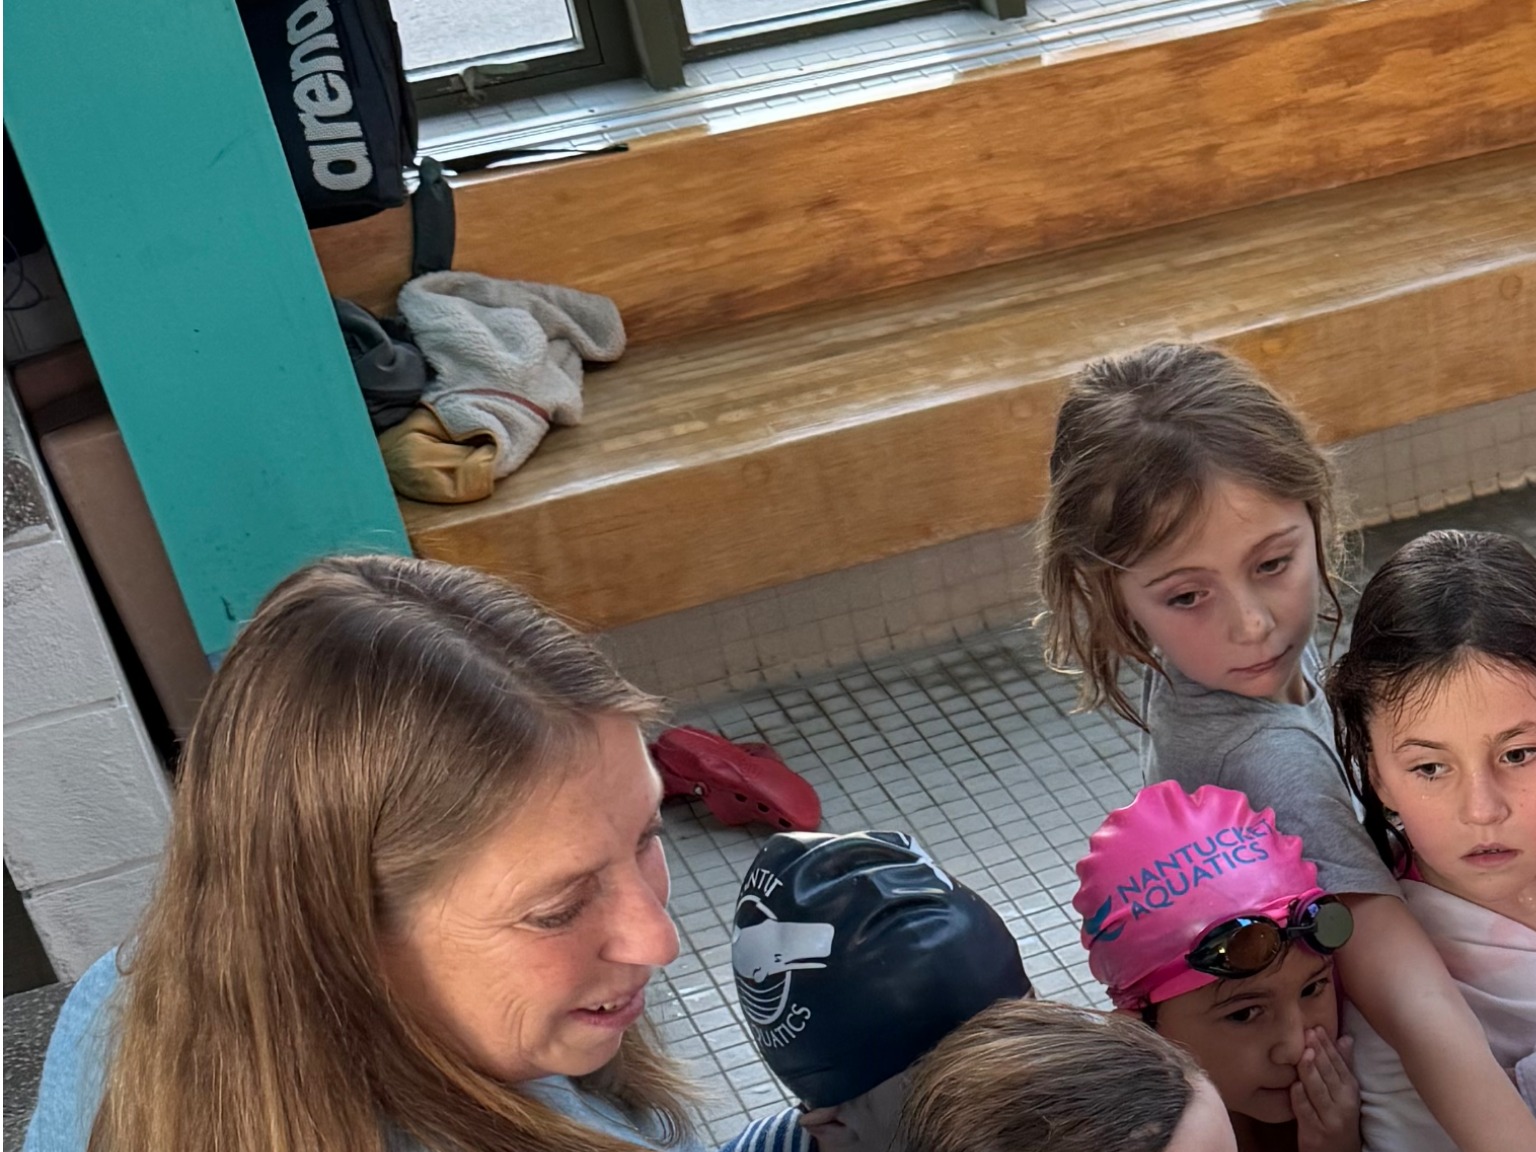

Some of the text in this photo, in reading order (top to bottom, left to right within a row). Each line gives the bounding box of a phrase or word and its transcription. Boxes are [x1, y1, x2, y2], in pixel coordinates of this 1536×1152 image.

[286, 0, 373, 191] arena
[1116, 818, 1274, 904] NANTUCKET
[1131, 841, 1270, 920] AQUATICS
